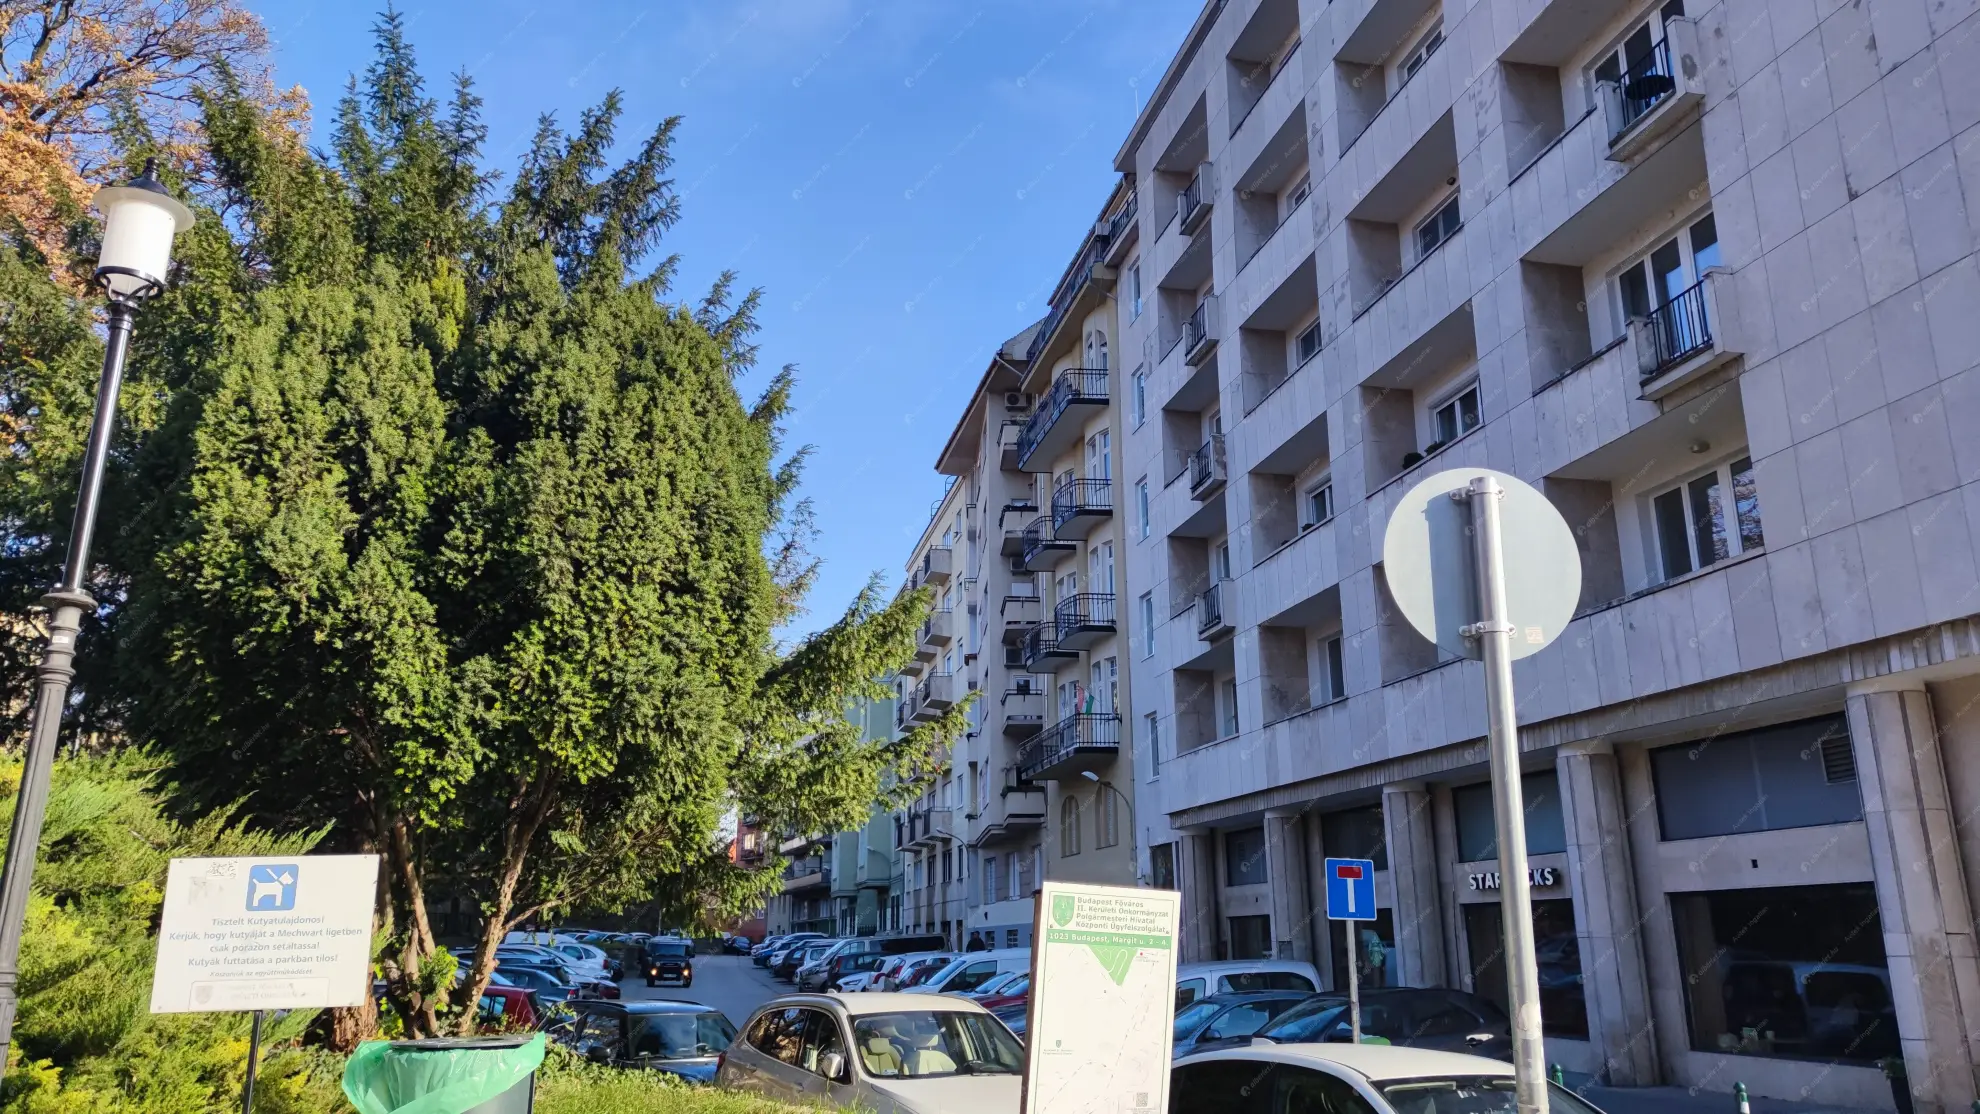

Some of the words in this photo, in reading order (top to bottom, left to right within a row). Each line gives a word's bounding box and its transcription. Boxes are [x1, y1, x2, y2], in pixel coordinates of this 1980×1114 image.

[1468, 867, 1554, 890] STARCKS
[1077, 897, 1113, 906] Budapest
[1114, 898, 1144, 908] Főváros
[1077, 904, 1086, 912] II.
[1088, 905, 1117, 914] Kerületi
[1118, 906, 1169, 918] Önkormányzat
[212, 917, 245, 926] Tisztelt
[247, 914, 325, 927] Kutyatulajdonos!
[1075, 920, 1109, 930] Központi
[1076, 912, 1128, 922] Polgármesteri
[1129, 916, 1156, 925] Hivatal
[169, 931, 201, 942] Kérjük,
[203, 931, 227, 941] hogy
[229, 929, 267, 940] kutyáját
[276, 928, 323, 937] Mechwart
[325, 927, 363, 938] ligetben
[1048, 933, 1069, 941] 1023
[1071, 933, 1110, 943] Budapest,
[1112, 935, 1137, 945] Margit
[209, 943, 229, 953] csak
[188, 957, 220, 967] Kutyák
[223, 956, 265, 965] futtatása
[275, 955, 313, 966] parkban
[316, 953, 338, 963] tilos!
